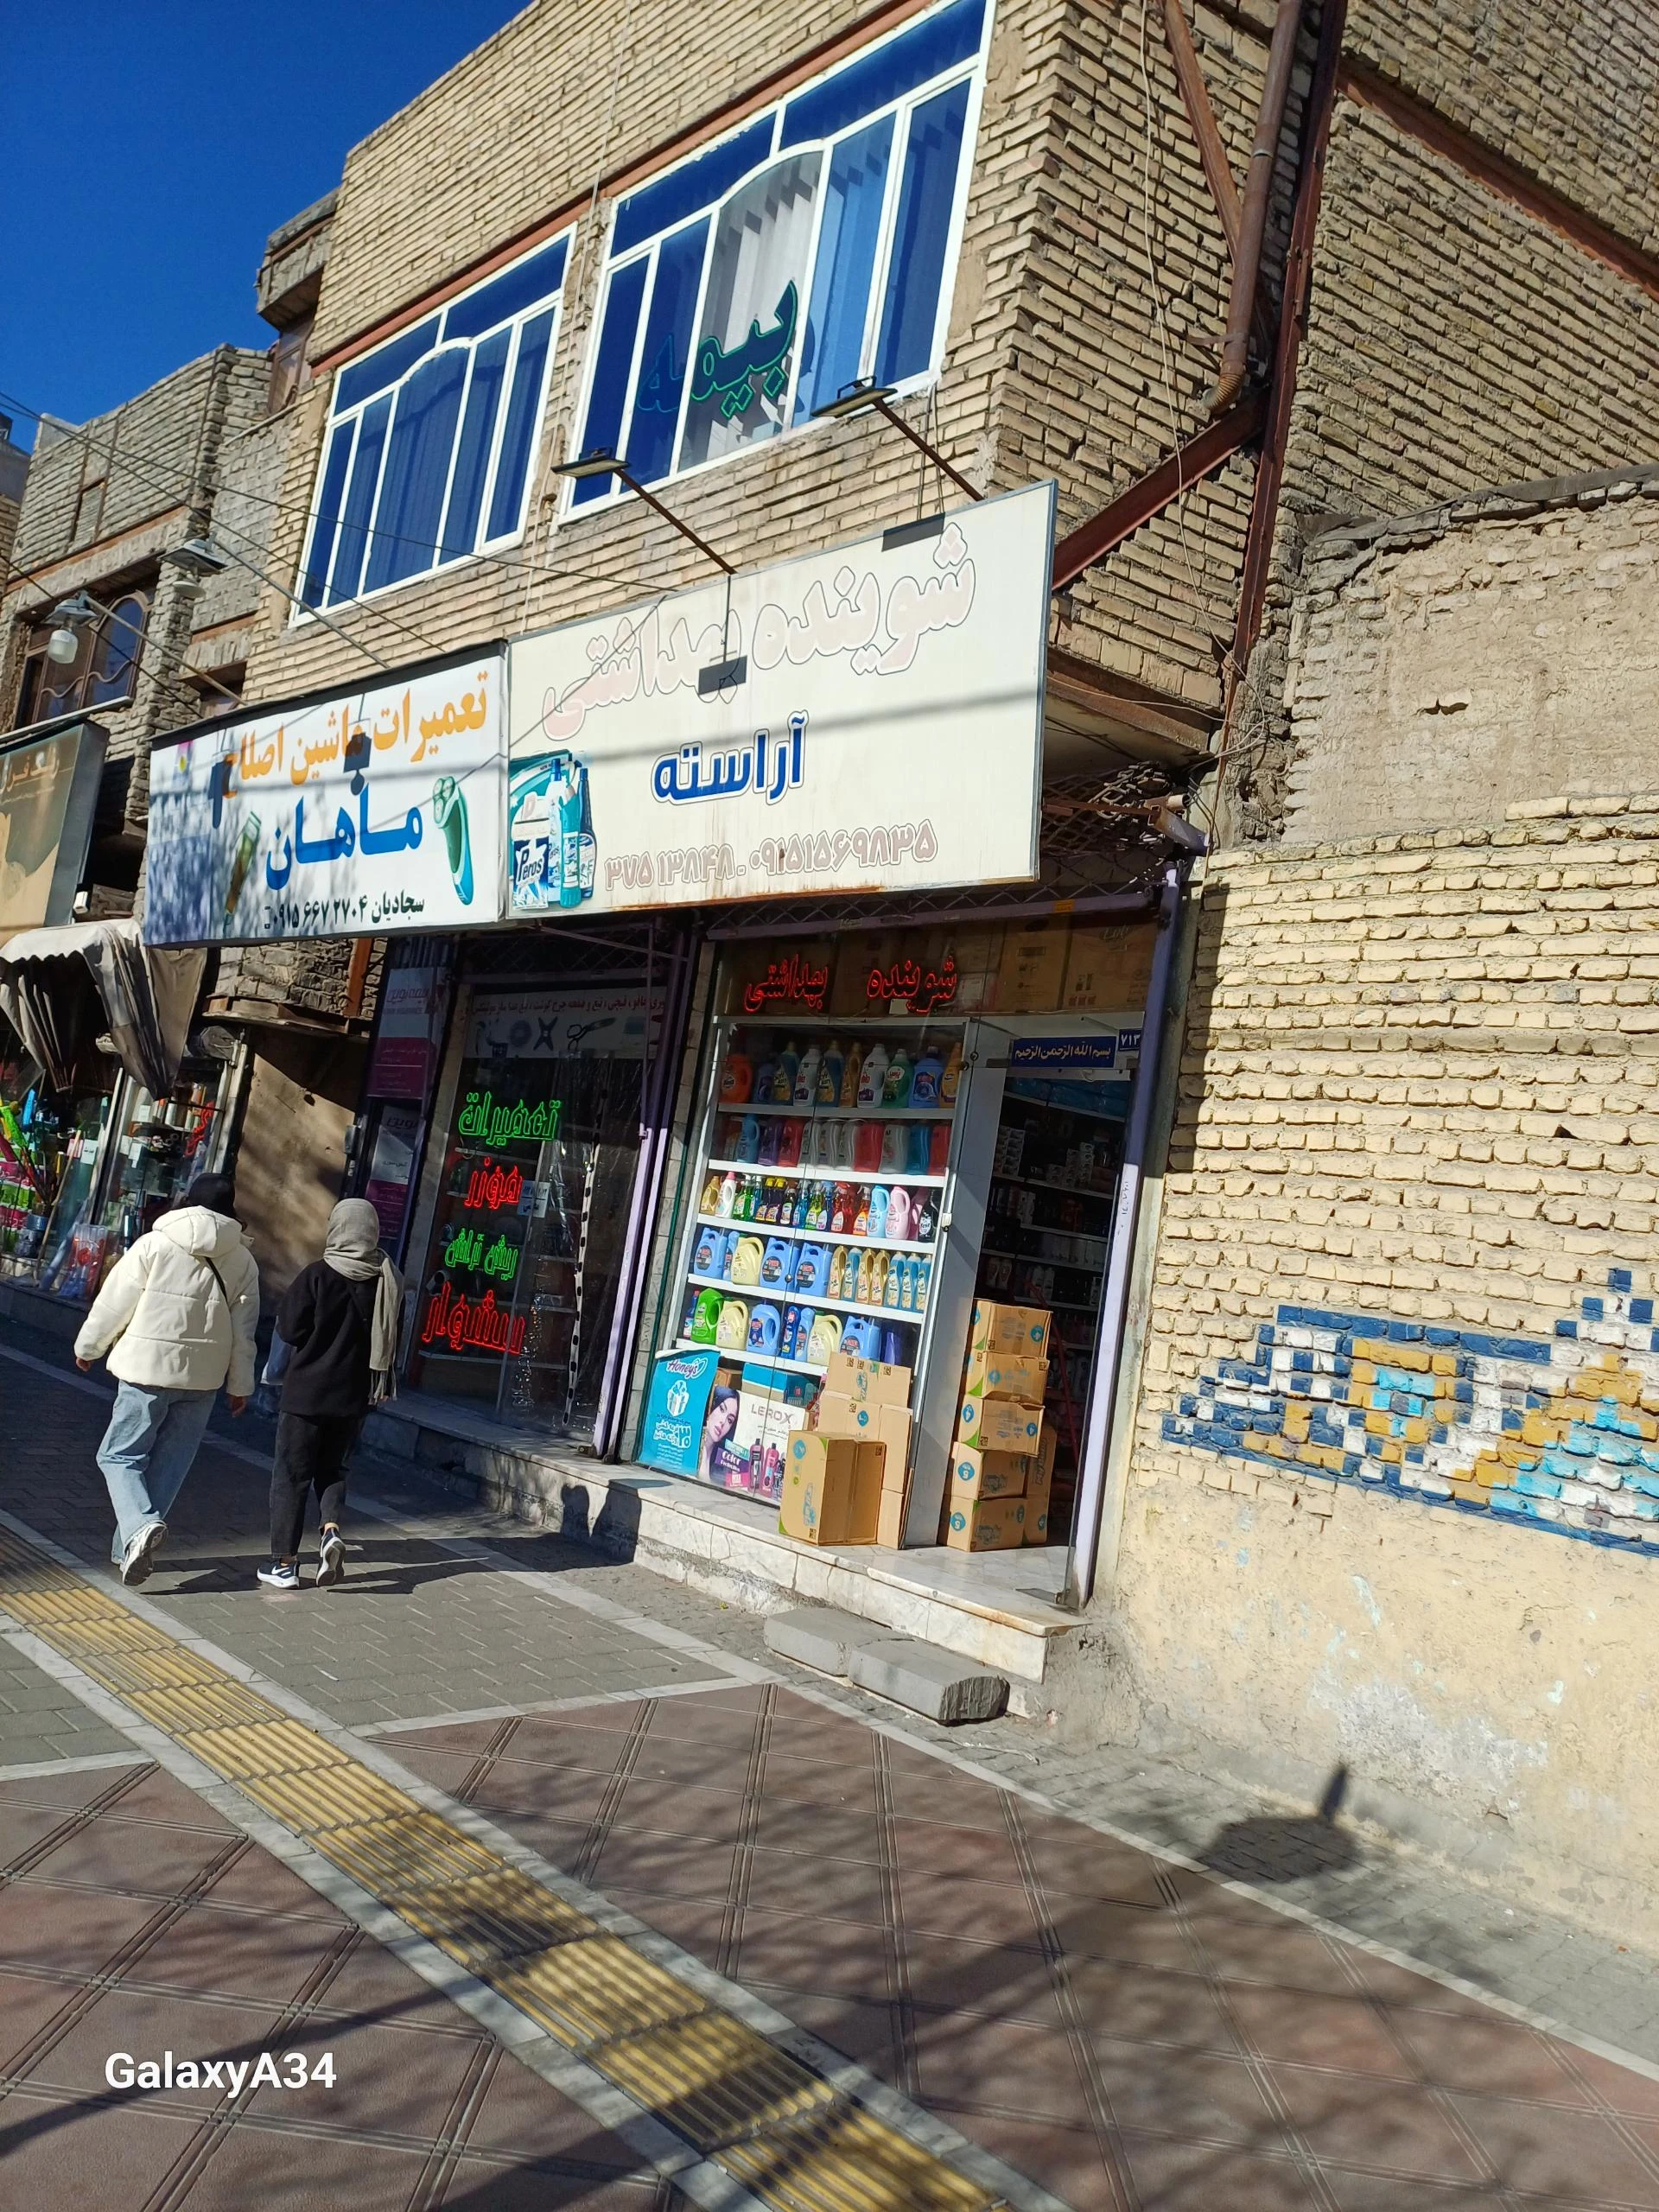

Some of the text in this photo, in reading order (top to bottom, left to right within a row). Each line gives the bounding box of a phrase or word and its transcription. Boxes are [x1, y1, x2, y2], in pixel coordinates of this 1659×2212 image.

[543, 522, 976, 741] شوینده بهداشتی
[223, 671, 489, 800] تعمیرات ماشین اصلاح
[652, 712, 807, 804] آراسته
[266, 781, 423, 892] ماهان
[517, 849, 543, 881] Peros
[372, 888, 424, 924] سجادیان
[744, 954, 957, 1014] شوینده بهداشتی
[459, 1091, 562, 1147] تعمیرات
[464, 1156, 524, 1210] موزر
[445, 1228, 518, 1281] ریش تراش
[422, 1281, 525, 1356] سشوار
[751, 1403, 794, 1424] LEROX
